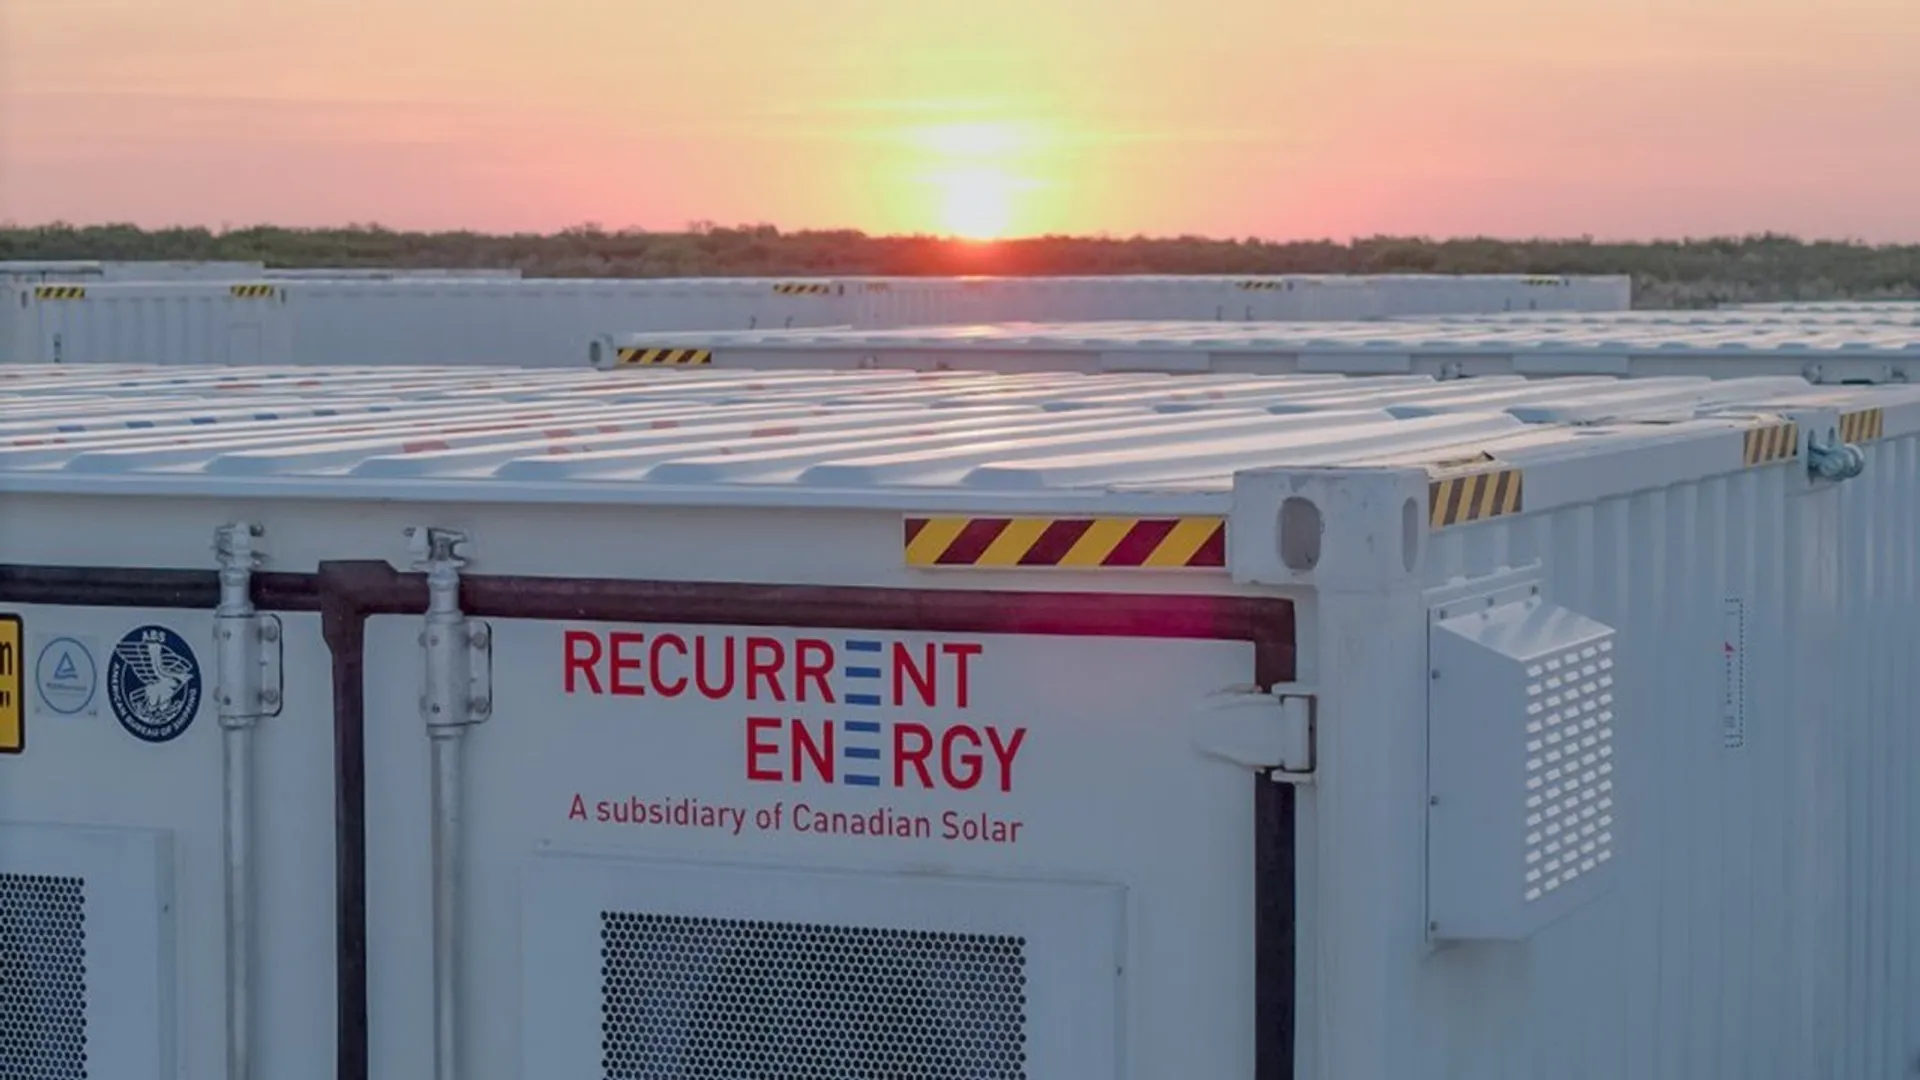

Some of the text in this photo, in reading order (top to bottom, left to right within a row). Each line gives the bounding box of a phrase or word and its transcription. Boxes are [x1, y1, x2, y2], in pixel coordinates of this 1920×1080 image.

[142, 629, 166, 642] ABS
[563, 630, 984, 708] RECURRENT
[745, 716, 1028, 794] ENERGY
[568, 794, 1024, 844] A subsidiary of Canadian Solar
